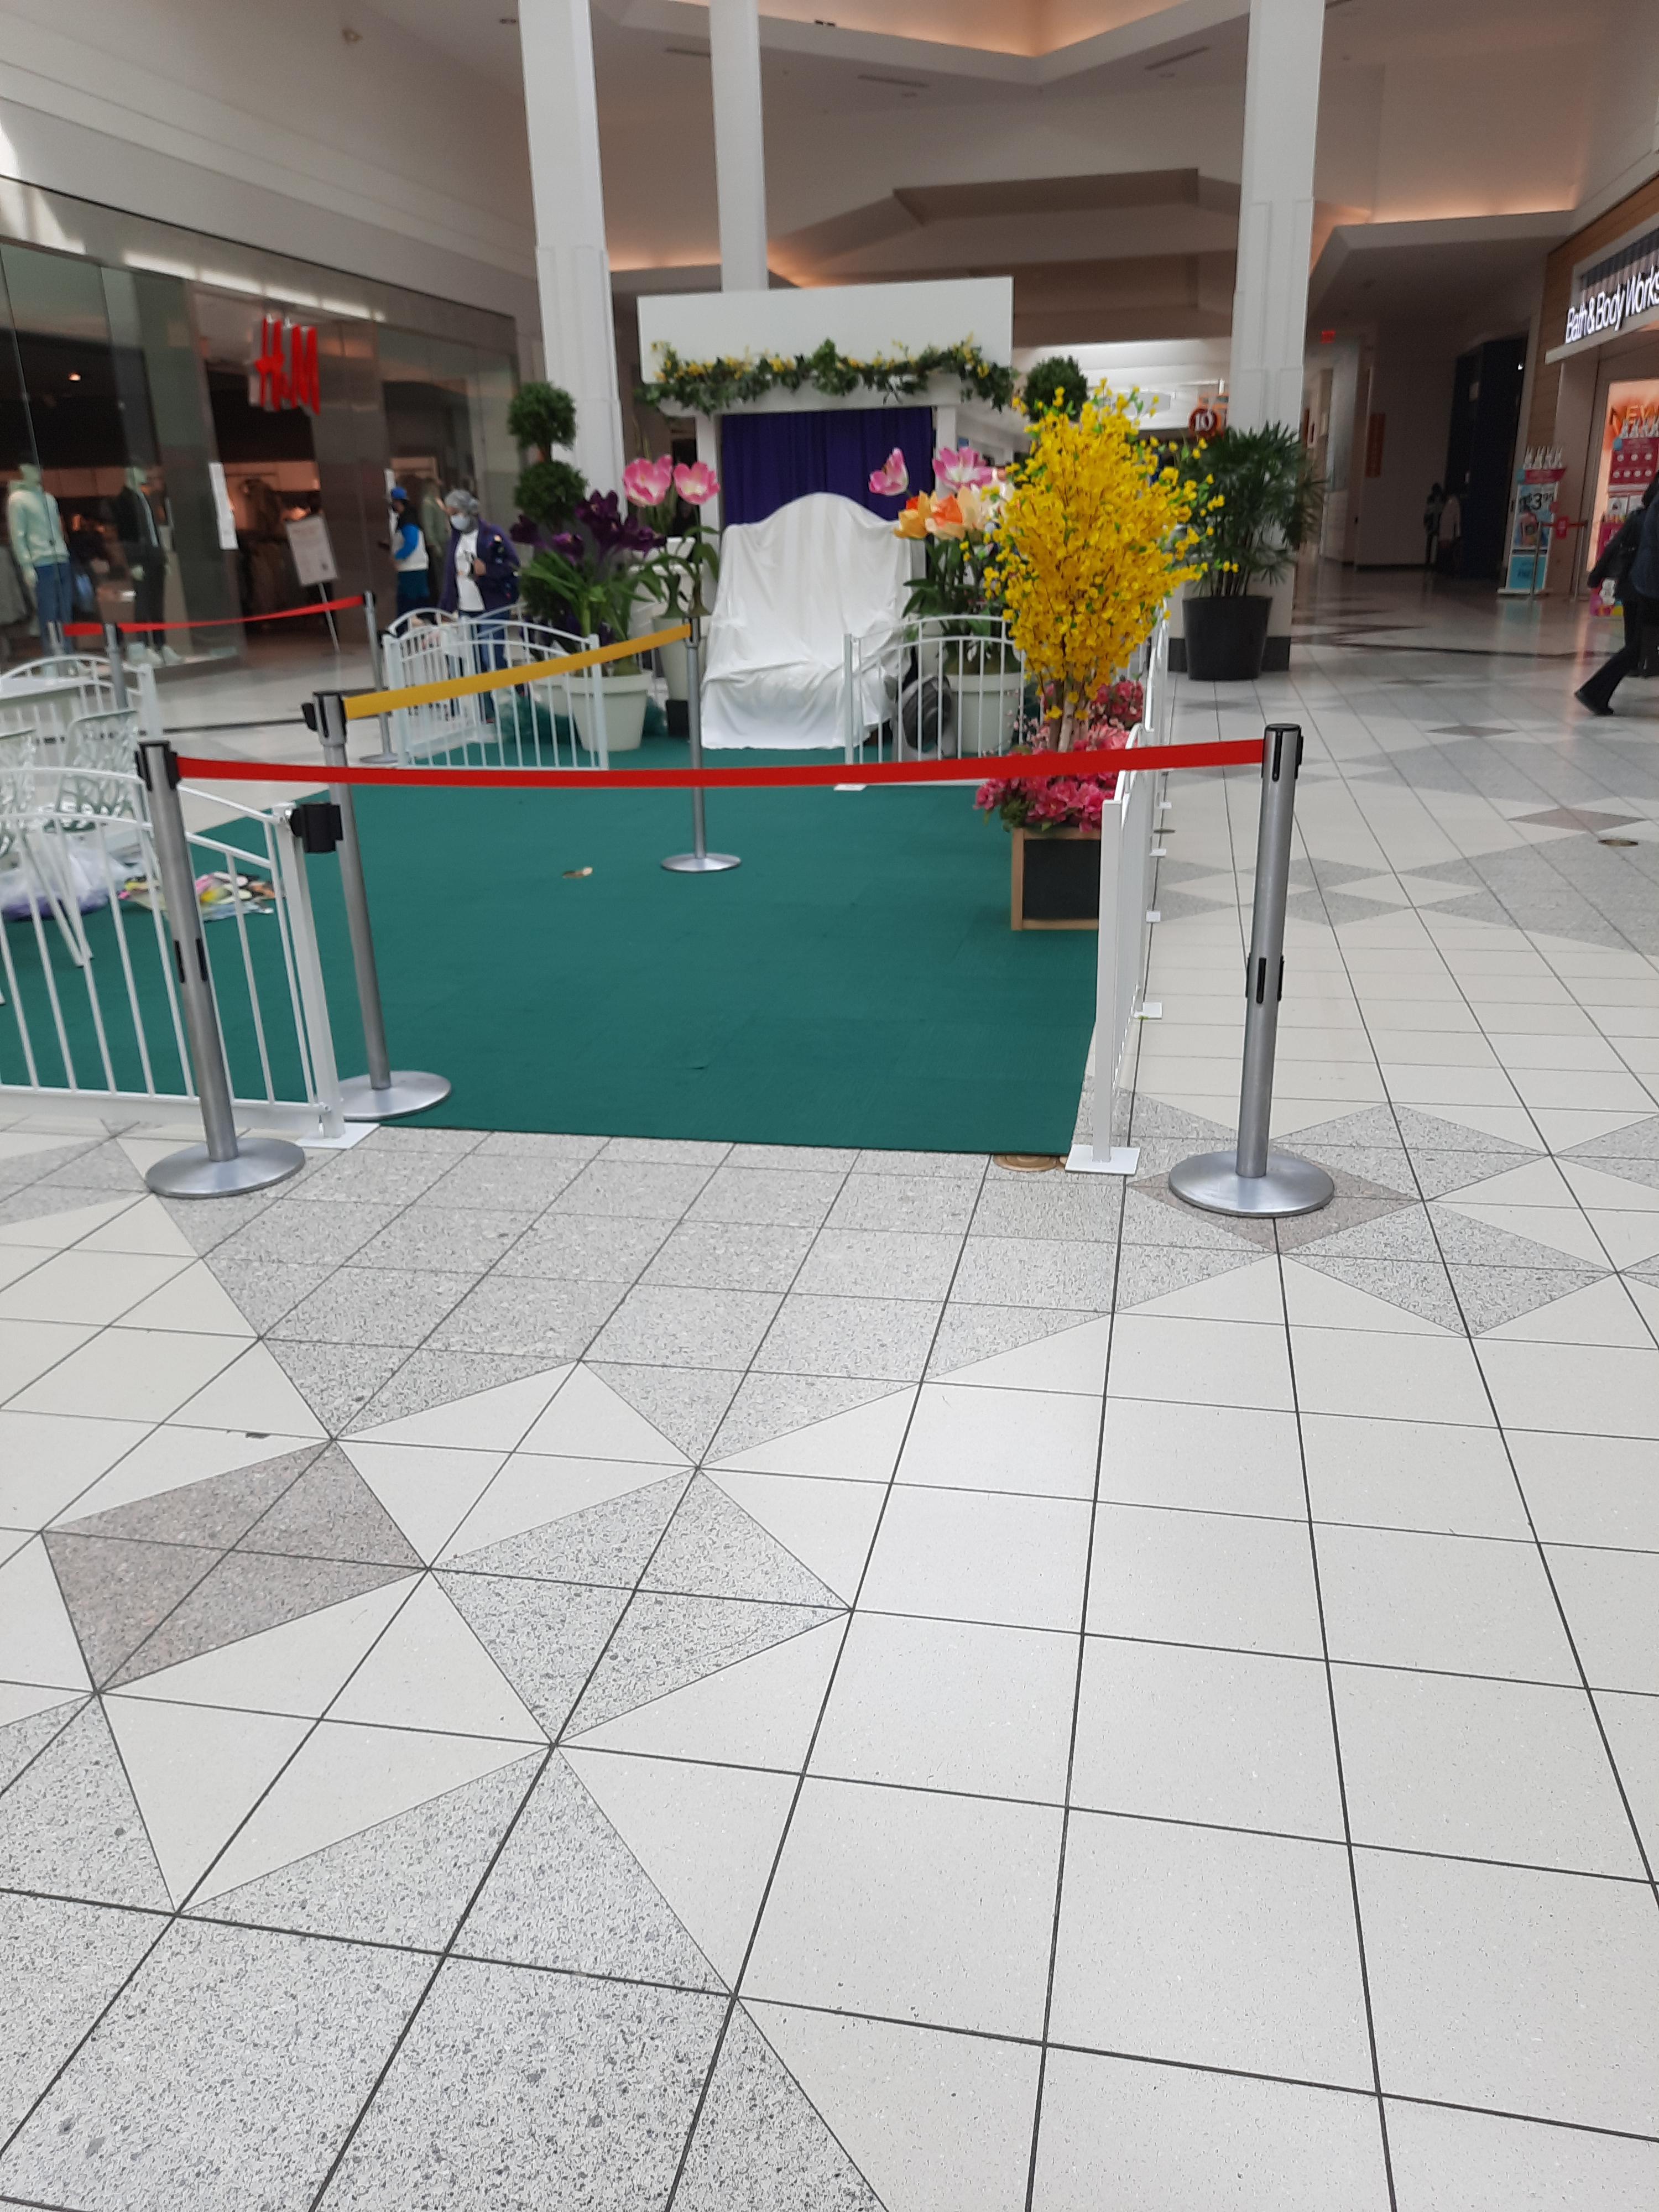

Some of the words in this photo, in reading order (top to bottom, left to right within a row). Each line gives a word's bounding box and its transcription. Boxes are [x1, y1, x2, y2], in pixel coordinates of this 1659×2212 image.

[1566, 302, 1588, 343] Bath
[1587, 296, 1595, 334] &
[1595, 283, 1625, 332] Body
[254, 317, 321, 416] H&M
